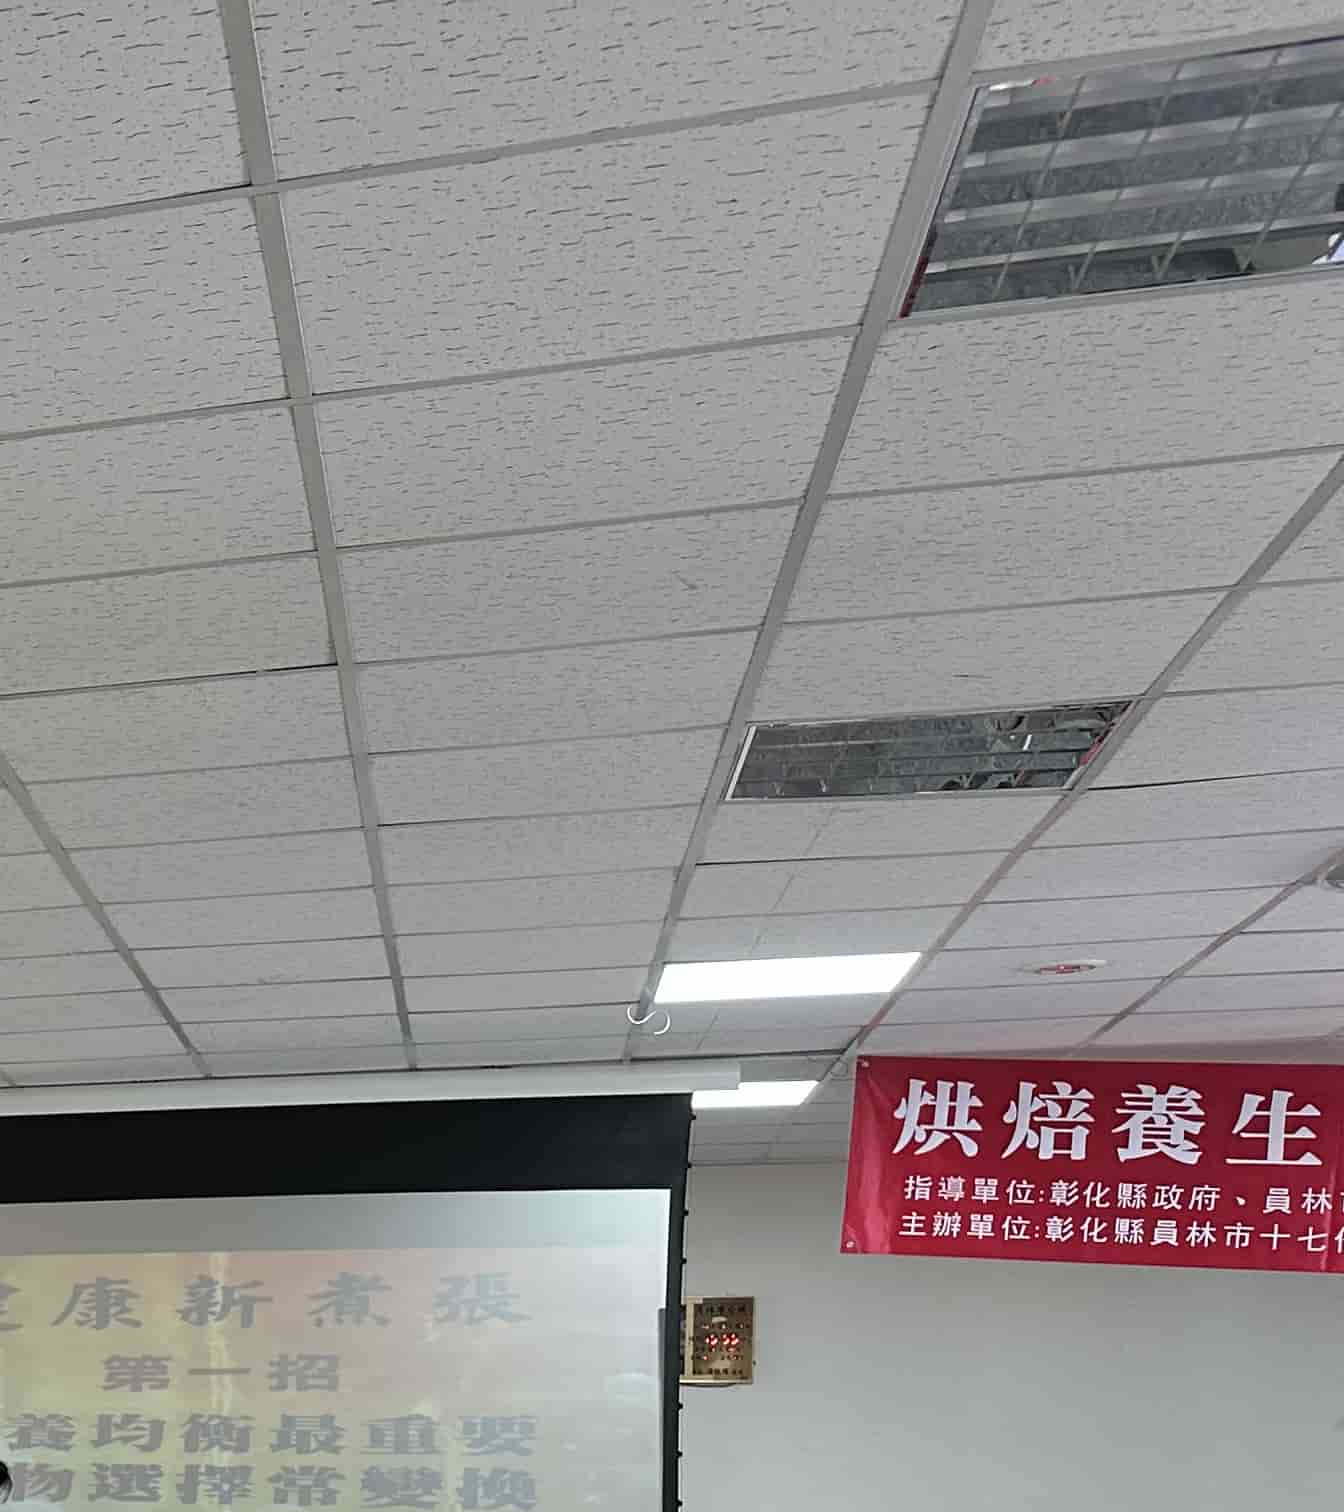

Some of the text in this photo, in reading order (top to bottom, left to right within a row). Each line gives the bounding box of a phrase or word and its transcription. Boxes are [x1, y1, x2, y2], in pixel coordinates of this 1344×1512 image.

[892, 1079, 1323, 1168] 烘焙養生
[904, 1175, 1343, 1215] 指導單位:彰化縣政府、員林
[102, 1354, 341, 1392] 第一招
[8, 1462, 539, 1512] 物選擇常變換
